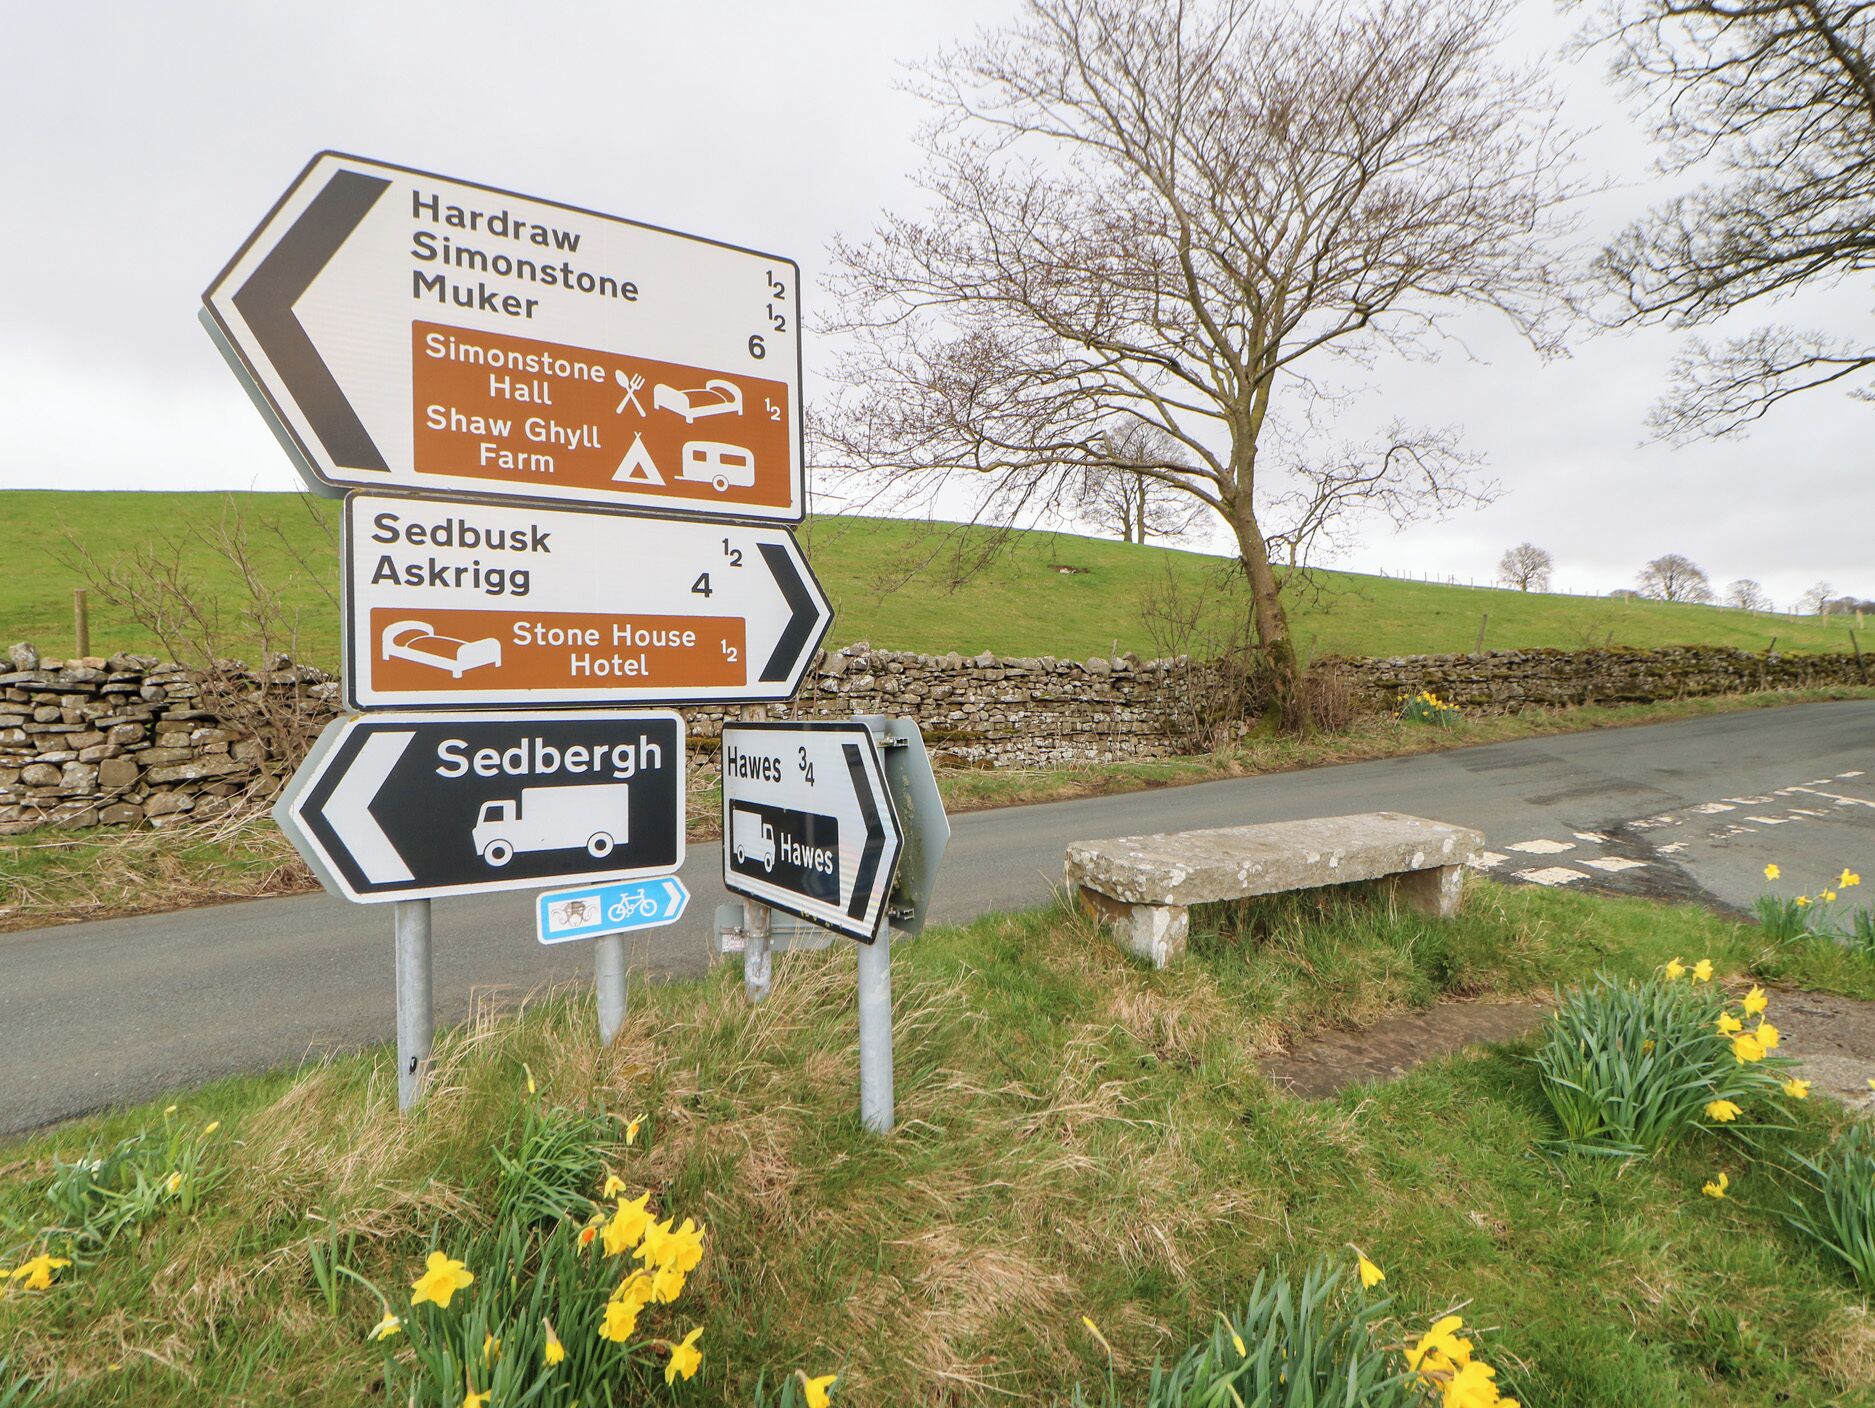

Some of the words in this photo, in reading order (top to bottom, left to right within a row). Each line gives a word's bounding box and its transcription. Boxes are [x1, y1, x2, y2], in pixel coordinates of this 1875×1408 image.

[411, 189, 581, 253] Hardraw
[410, 231, 639, 301] Simonstone
[412, 270, 539, 320] Muker
[748, 334, 766, 360] 6
[425, 333, 606, 383] Simonstone
[489, 373, 552, 405] Hall
[426, 405, 512, 438] Shaw
[524, 418, 601, 449] Ghyll
[479, 443, 555, 473] Farm
[371, 512, 552, 554] Sedbusk
[370, 555, 532, 597] Askrigg
[690, 572, 713, 598] 4
[511, 621, 600, 647] Stone
[611, 623, 697, 649] House
[570, 653, 649, 677] Hotel
[435, 734, 662, 779] Sedbergh
[727, 745, 782, 784] Hawes
[779, 832, 834, 876] Hawes
